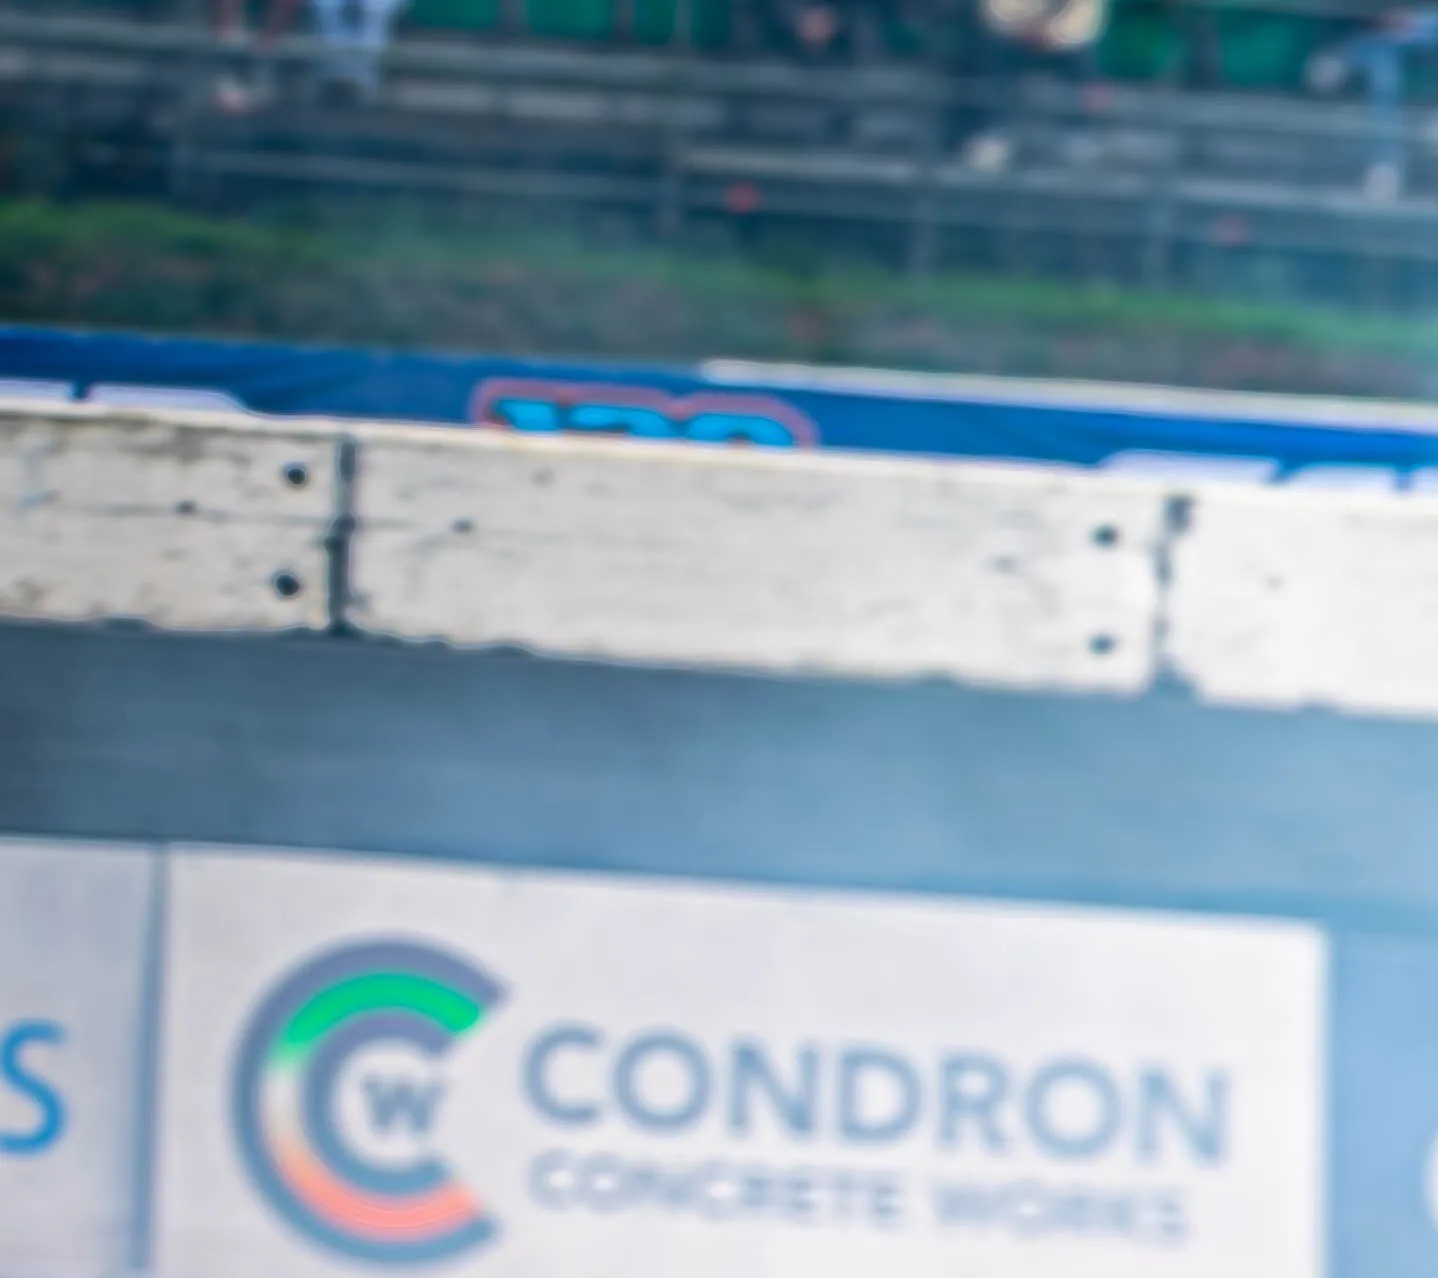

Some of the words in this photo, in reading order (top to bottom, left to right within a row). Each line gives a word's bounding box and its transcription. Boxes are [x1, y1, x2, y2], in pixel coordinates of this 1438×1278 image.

[522, 1021, 1232, 1169] CONDRON
[529, 1148, 904, 1230] CONCRETE
[933, 1178, 1192, 1248] WORKS
